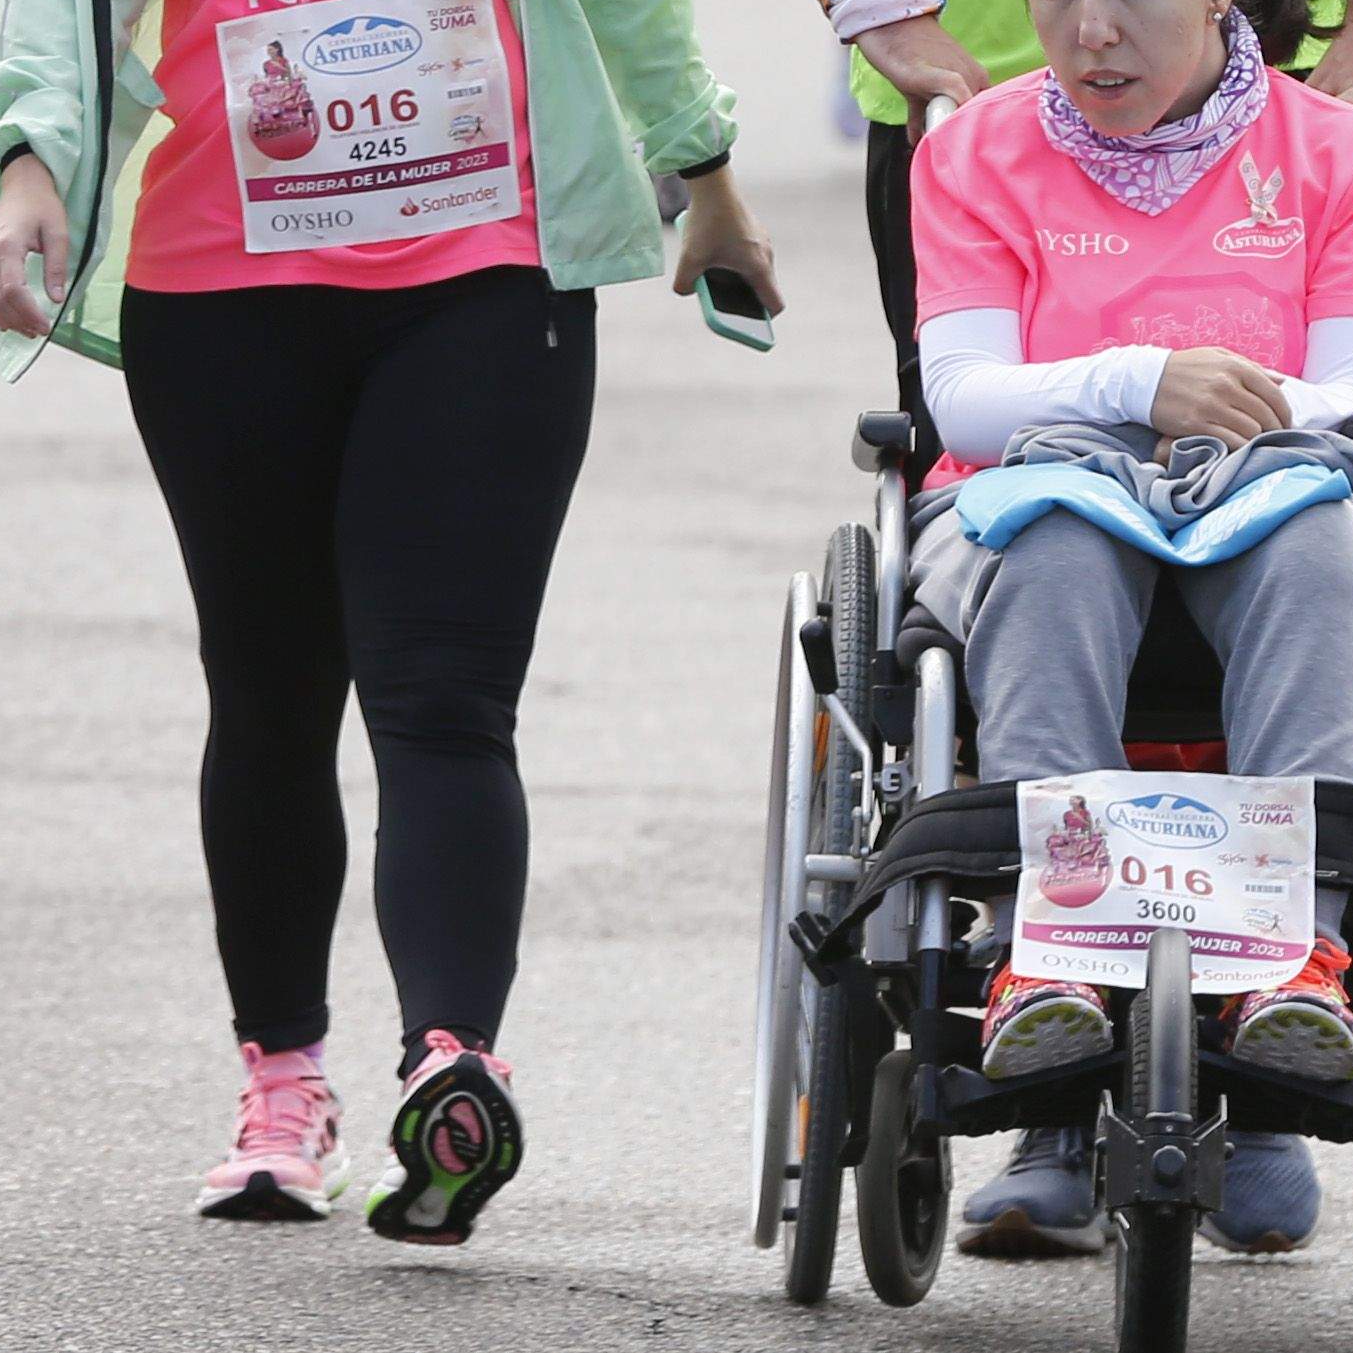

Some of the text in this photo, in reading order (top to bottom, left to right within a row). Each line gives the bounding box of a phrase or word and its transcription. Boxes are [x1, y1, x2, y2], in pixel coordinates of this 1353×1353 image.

[430, 13, 477, 31] SUMA
[327, 89, 419, 132] 016
[349, 136, 407, 162] 4245
[274, 152, 489, 195] CARRERA DE LA MUJER 2023
[422, 186, 499, 214] Santander
[271, 209, 354, 232] OYSHO
[1238, 812, 1294, 825] SUMA
[1239, 803, 1295, 812] TU DORSAL
[1121, 855, 1213, 896] 016
[1137, 898, 1196, 923] 3600
[1050, 930, 1130, 944] CARRERA
[1189, 935, 1242, 953] MUJER
[1247, 943, 1285, 958] 2023
[1042, 954, 1129, 976] OYSHO
[1203, 968, 1291, 982] Santander
